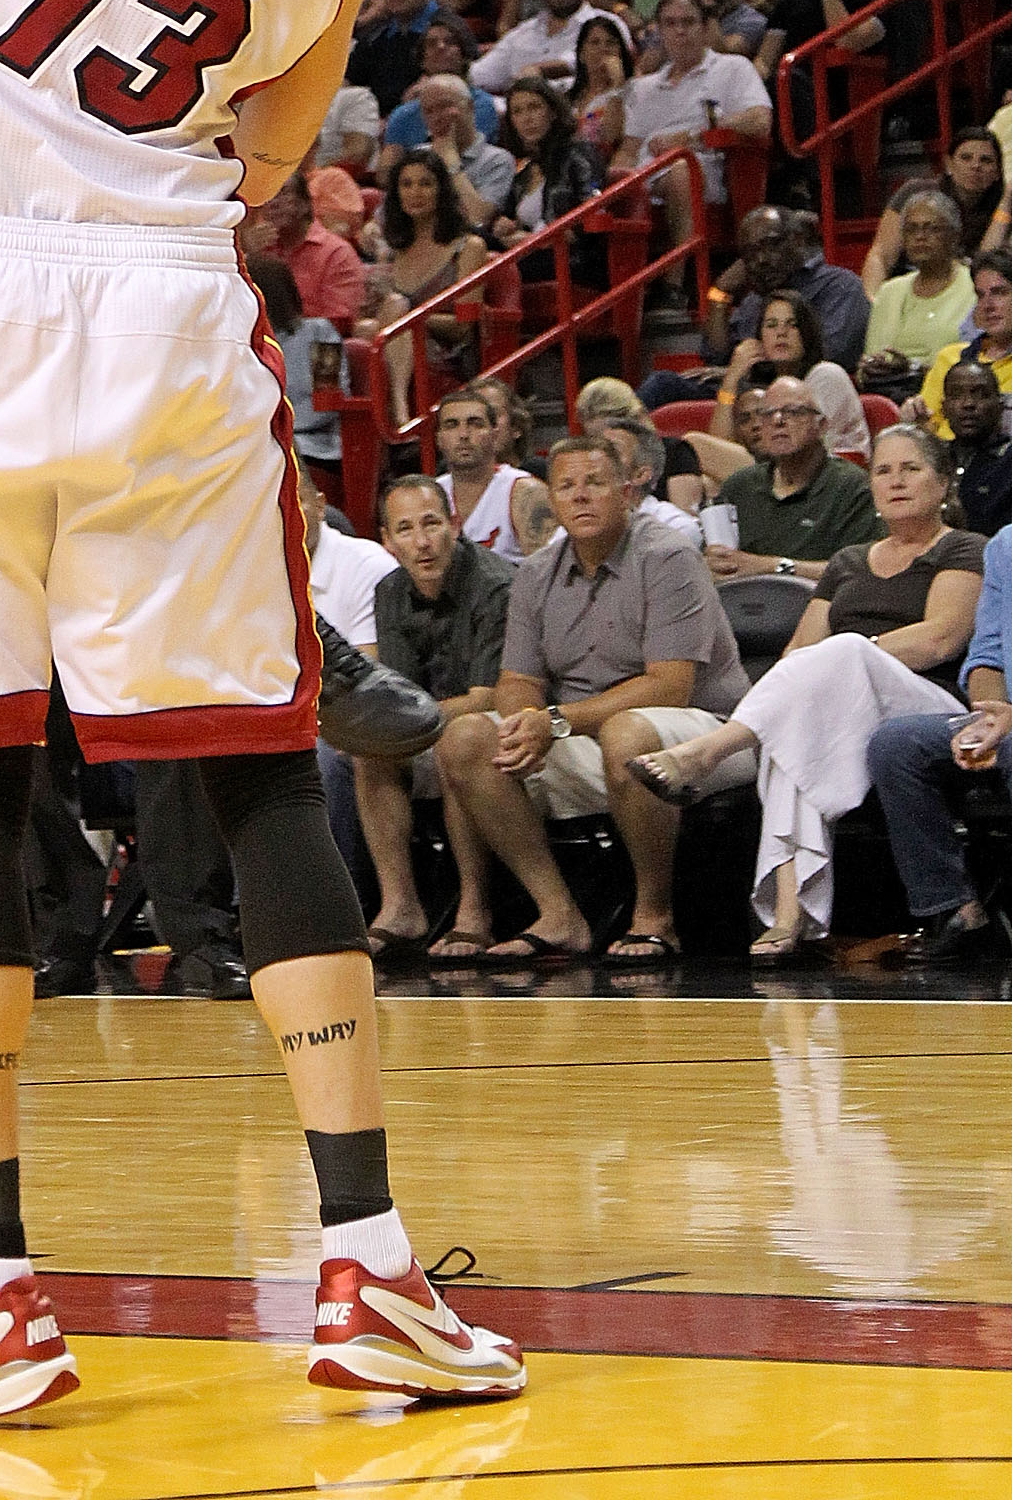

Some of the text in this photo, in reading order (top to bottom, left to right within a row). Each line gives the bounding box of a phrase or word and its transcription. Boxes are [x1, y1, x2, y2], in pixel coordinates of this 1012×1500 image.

[280, 1019, 356, 1053] MY WAY
[316, 1302, 354, 1326] NIKE
